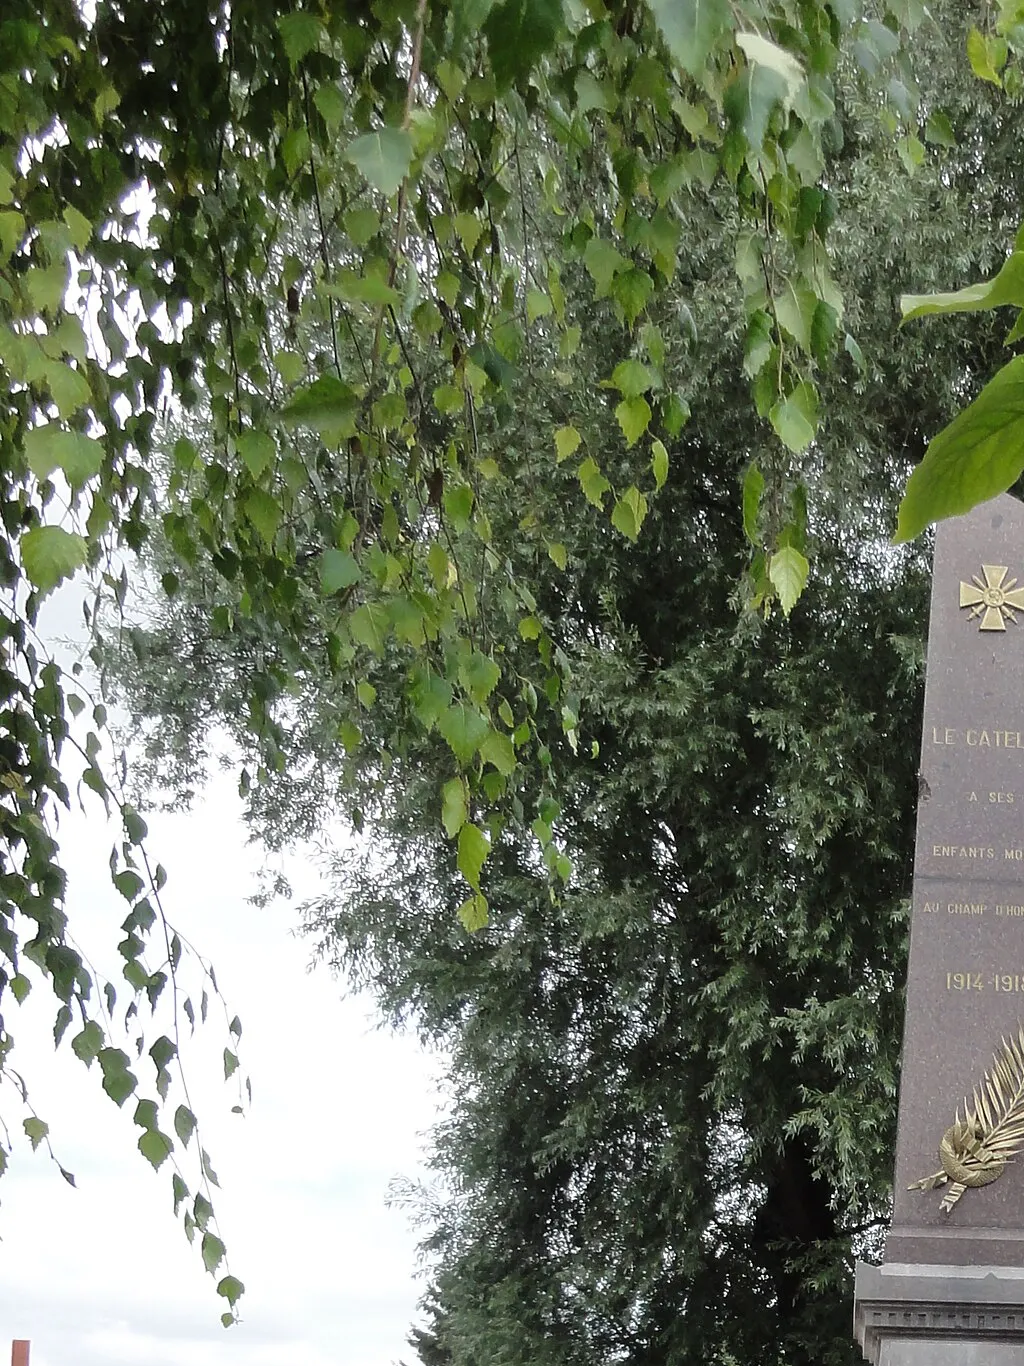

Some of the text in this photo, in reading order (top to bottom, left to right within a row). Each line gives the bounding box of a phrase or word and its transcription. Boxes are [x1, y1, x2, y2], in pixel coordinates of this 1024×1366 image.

[933, 727, 957, 746] LE
[988, 791, 1015, 804] SES
[933, 844, 995, 860] ENFANTS
[923, 901, 940, 914] AU
[947, 902, 988, 916] CHAMP
